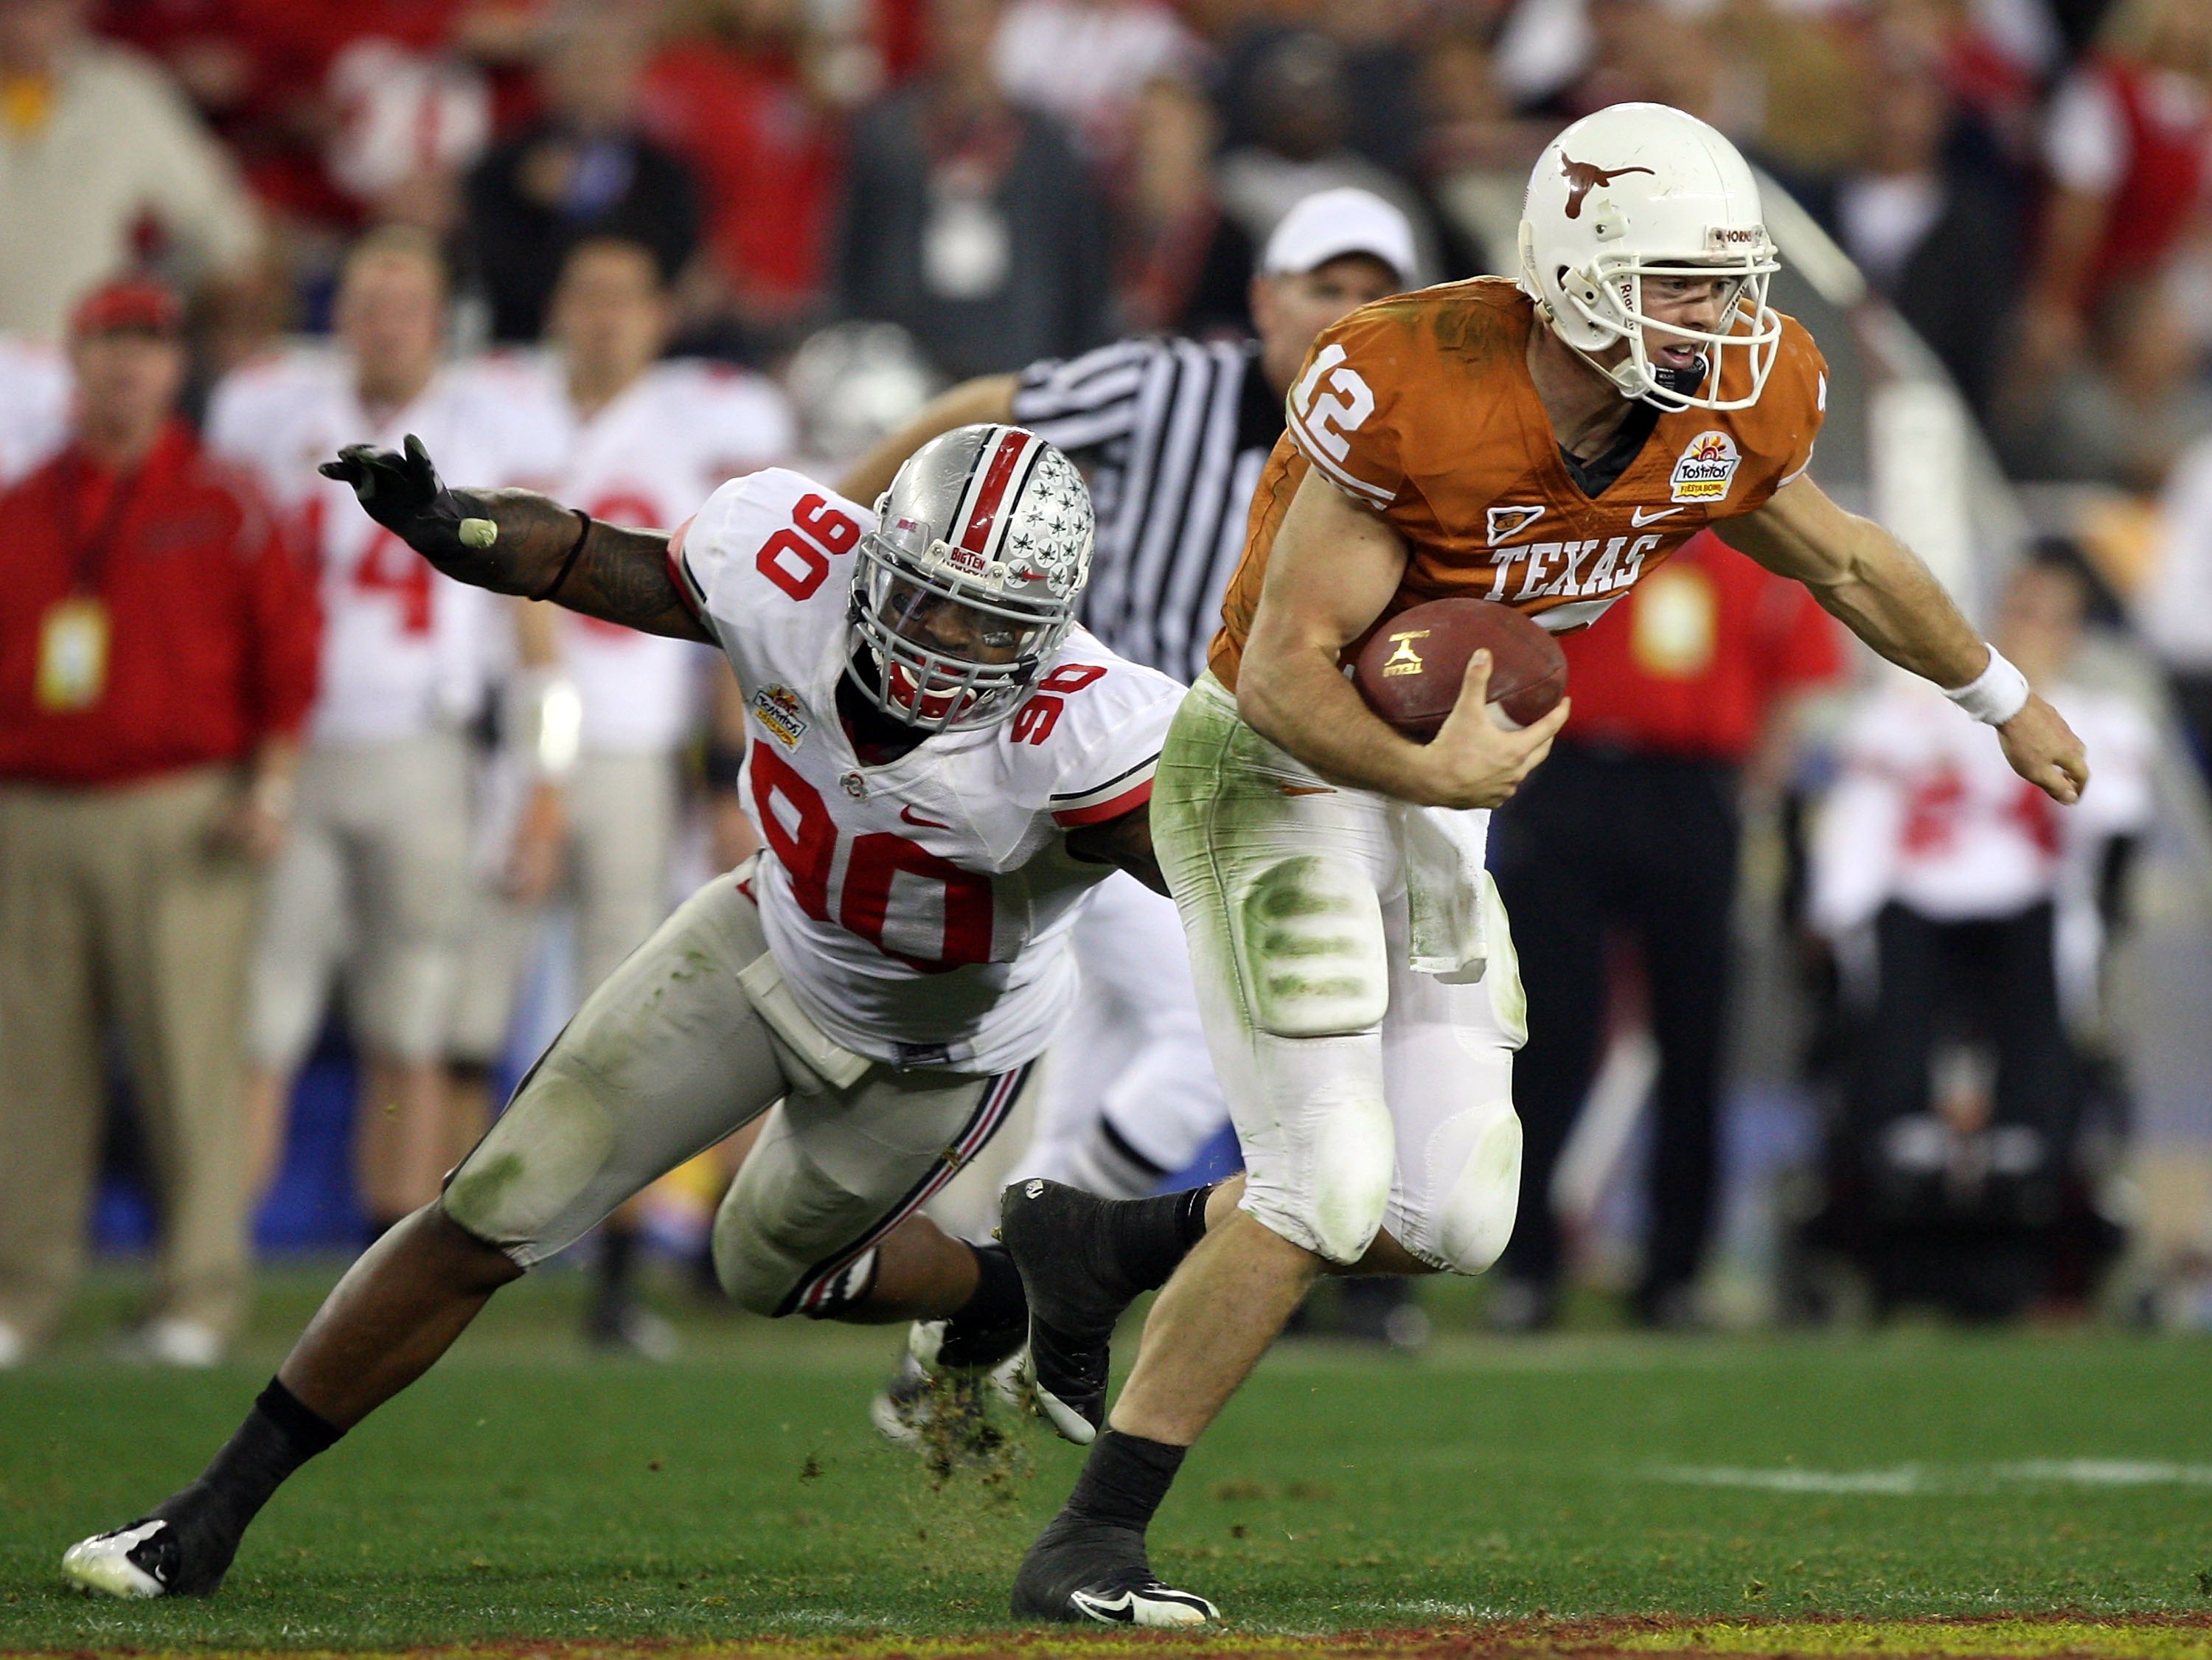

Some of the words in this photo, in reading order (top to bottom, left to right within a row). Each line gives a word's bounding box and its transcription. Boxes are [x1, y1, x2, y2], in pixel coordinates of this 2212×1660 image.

[1291, 343, 1375, 463] 12
[1483, 534, 1663, 601] TEXAS
[1009, 663, 1108, 746] 90
[750, 737, 994, 976] 90
